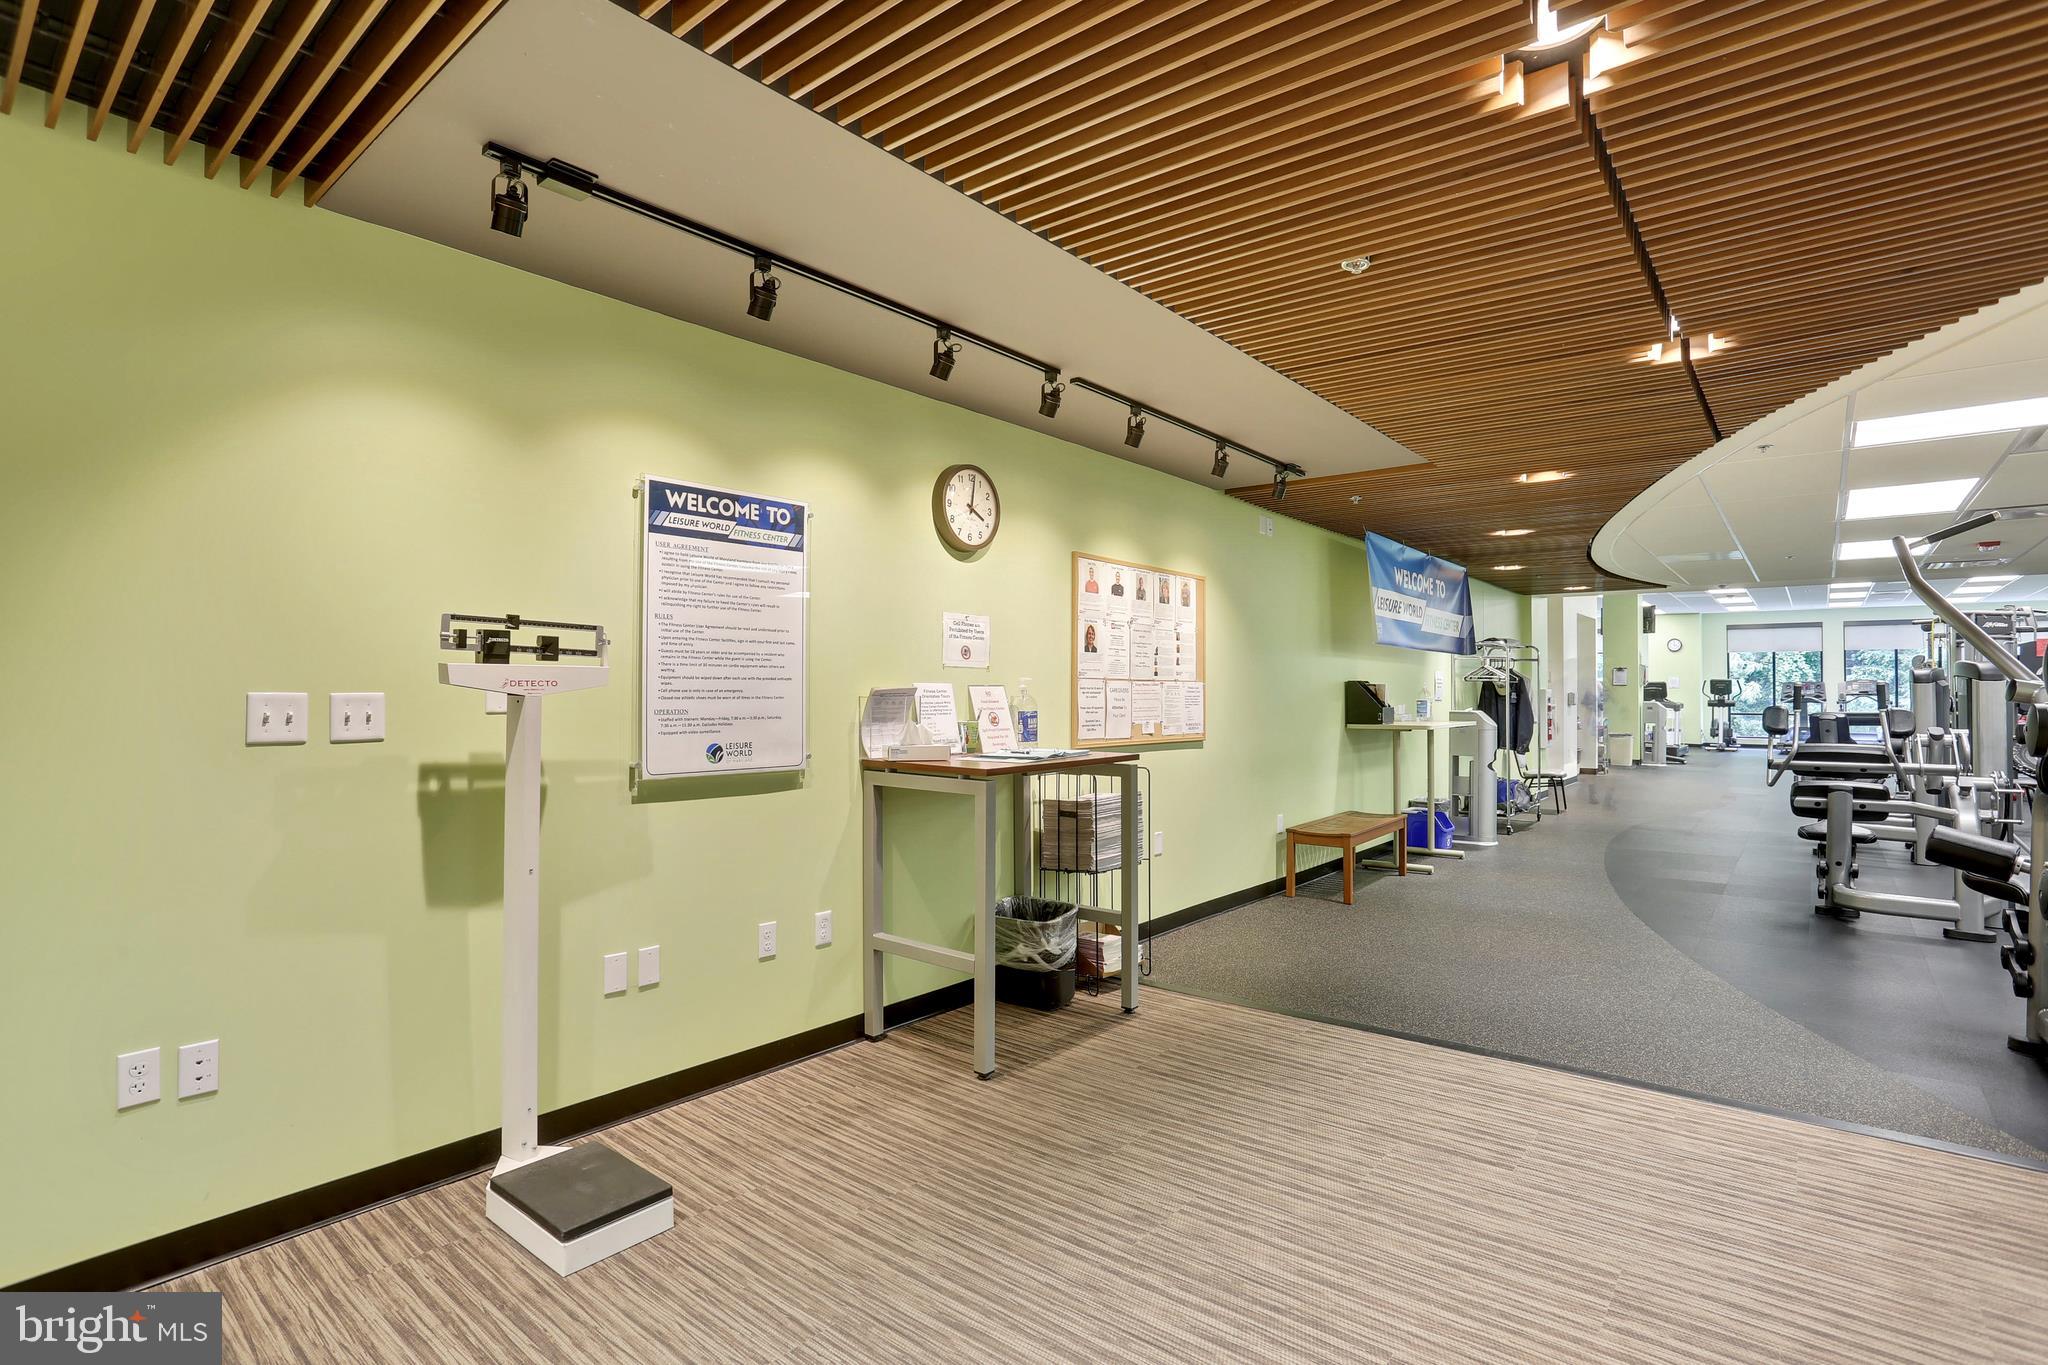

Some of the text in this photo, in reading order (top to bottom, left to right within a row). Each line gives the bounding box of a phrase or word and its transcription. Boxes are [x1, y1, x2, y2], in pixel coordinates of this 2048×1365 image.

[957, 474, 964, 484] 11
[985, 492, 990, 500] 2
[665, 489, 791, 526] WELCOME TO
[946, 498, 952, 508] 9
[987, 508, 992, 516] 3
[950, 514, 955, 524] 8
[668, 516, 788, 544] LEISURE WORLD FITNESS CENTER
[957, 528, 962, 536] 7
[968, 532, 972, 542] 6
[978, 531, 983, 540] 5
[672, 544, 710, 552] AGREEMENT
[1394, 566, 1446, 599] WELCOME TO
[1377, 596, 1402, 614] LEISURE
[1402, 602, 1424, 618] WORLD
[725, 742, 752, 750] LEISURE
